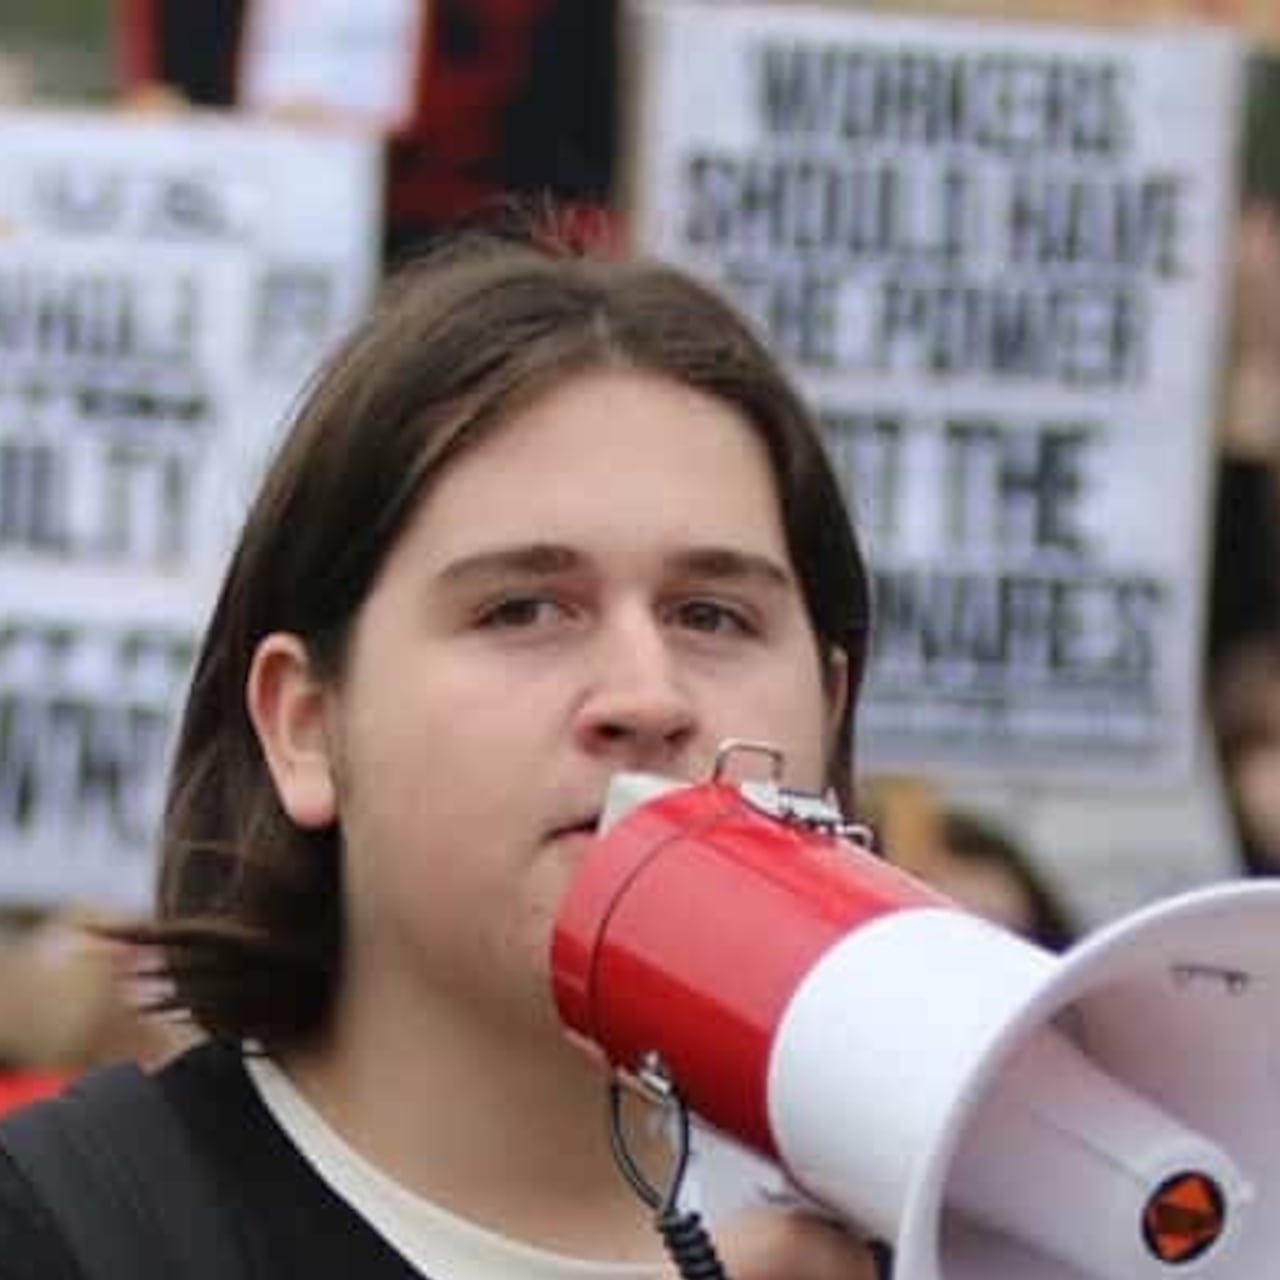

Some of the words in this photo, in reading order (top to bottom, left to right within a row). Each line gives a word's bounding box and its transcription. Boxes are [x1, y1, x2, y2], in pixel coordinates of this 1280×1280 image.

[754, 42, 1128, 158] WORKERS
[682, 150, 971, 262] SHOULD
[1004, 166, 1194, 280] HAVE
[878, 274, 1152, 388] POWER
